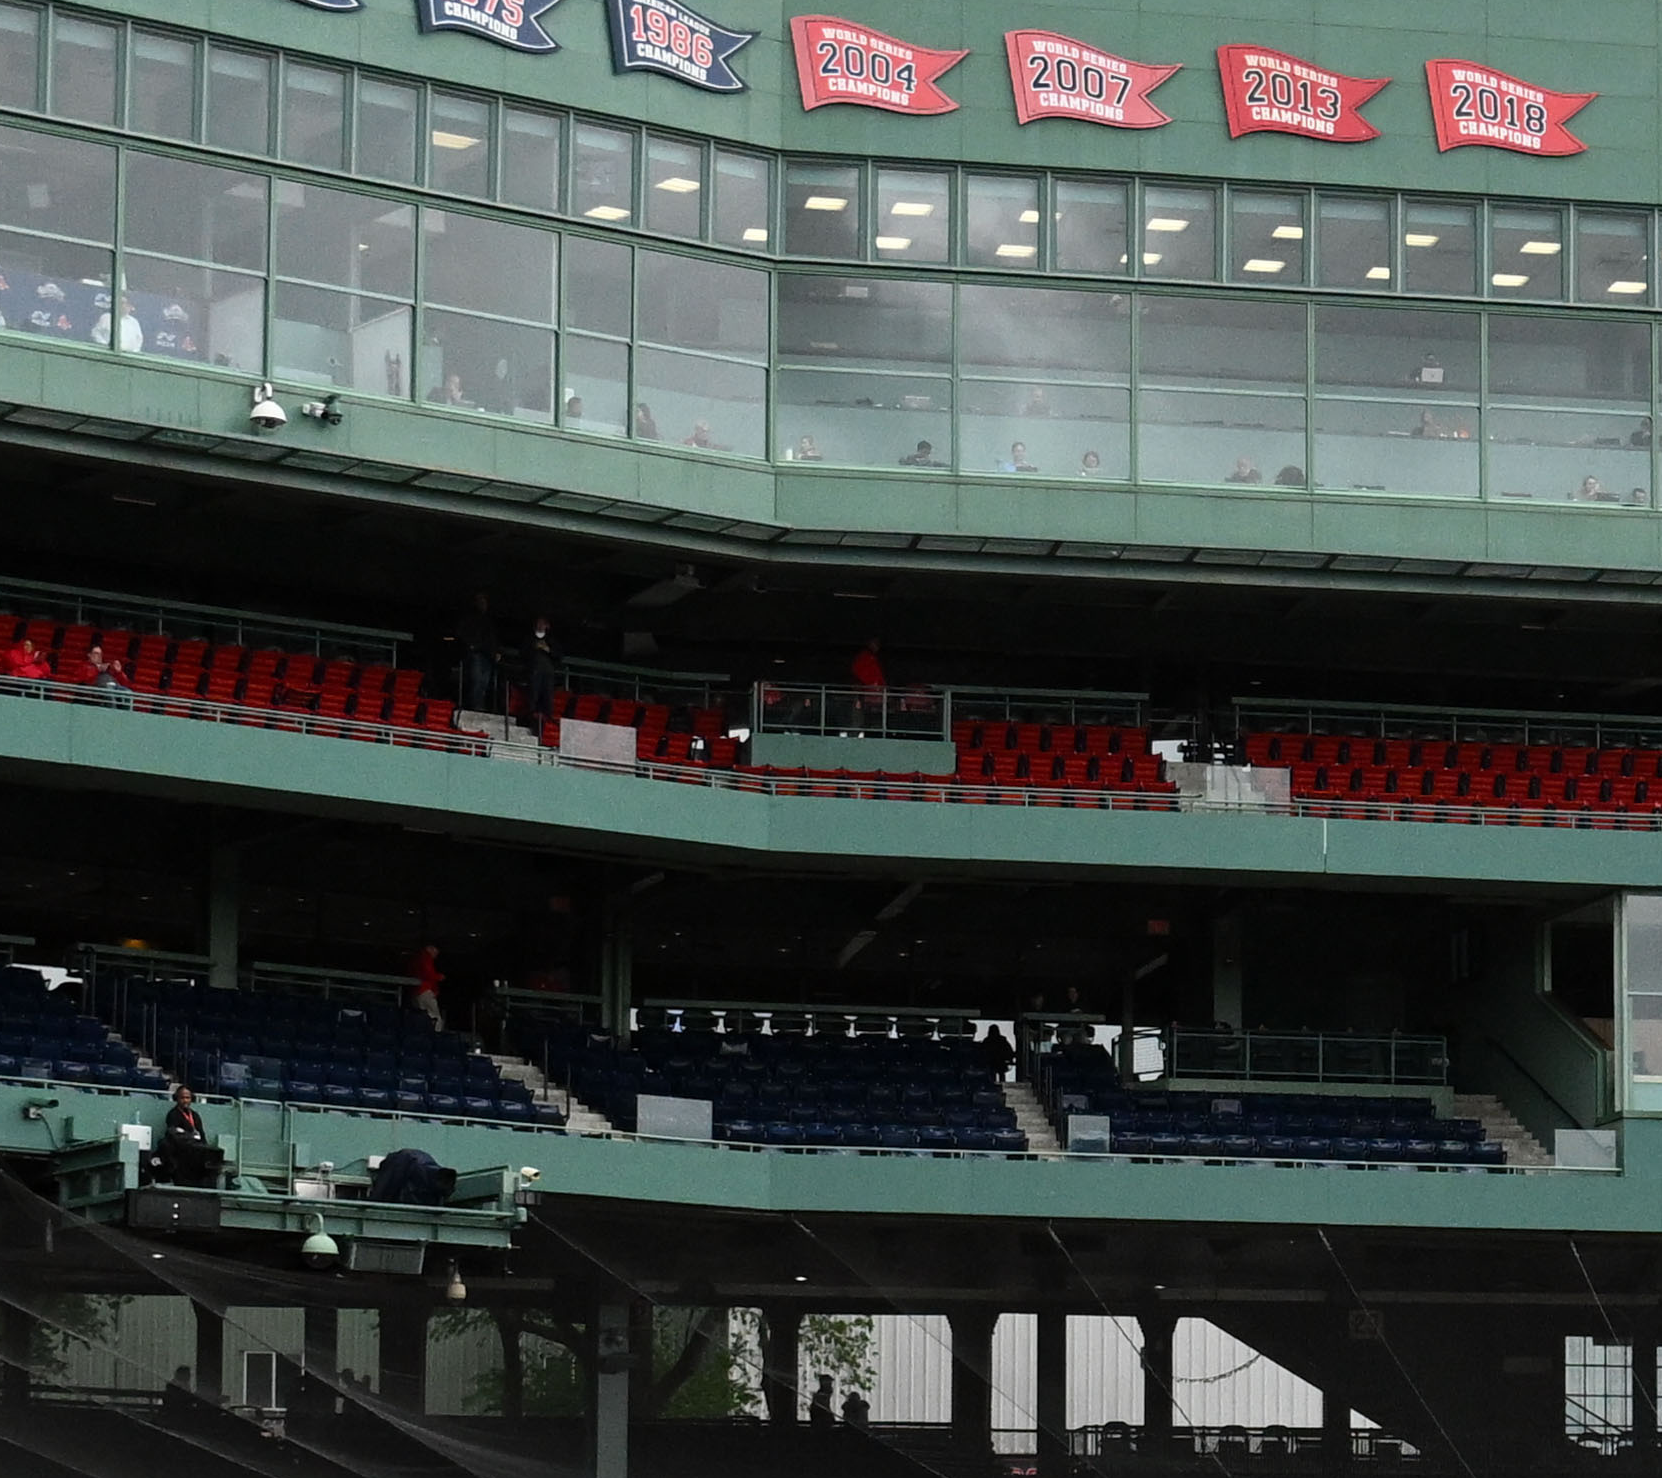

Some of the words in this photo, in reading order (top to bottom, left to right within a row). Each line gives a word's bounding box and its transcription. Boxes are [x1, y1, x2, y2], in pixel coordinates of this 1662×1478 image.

[444, 1, 518, 42] CHAMPIONS
[630, 4, 714, 69] 1986
[678, 12, 710, 36] LEAGUE
[822, 27, 867, 46] WORLD
[870, 38, 913, 61] SERIES
[1032, 40, 1080, 60] WORLD
[1082, 51, 1127, 74] SERIES
[636, 43, 708, 82] CHAMPIONS
[817, 41, 918, 94] 2004
[1244, 54, 1291, 74] WORLD
[1293, 65, 1338, 88] SERIES
[827, 76, 910, 106] CHAMPIONS
[1027, 54, 1132, 108] 2007
[1243, 68, 1341, 121] 2013
[1453, 69, 1497, 88] WORLD
[1500, 79, 1544, 103] SERIES
[1039, 91, 1124, 121] CHAMPIONS
[1251, 106, 1334, 135] CHAMPIONS
[1450, 83, 1546, 136] 2018
[1459, 121, 1540, 150] CHAMPIONS
